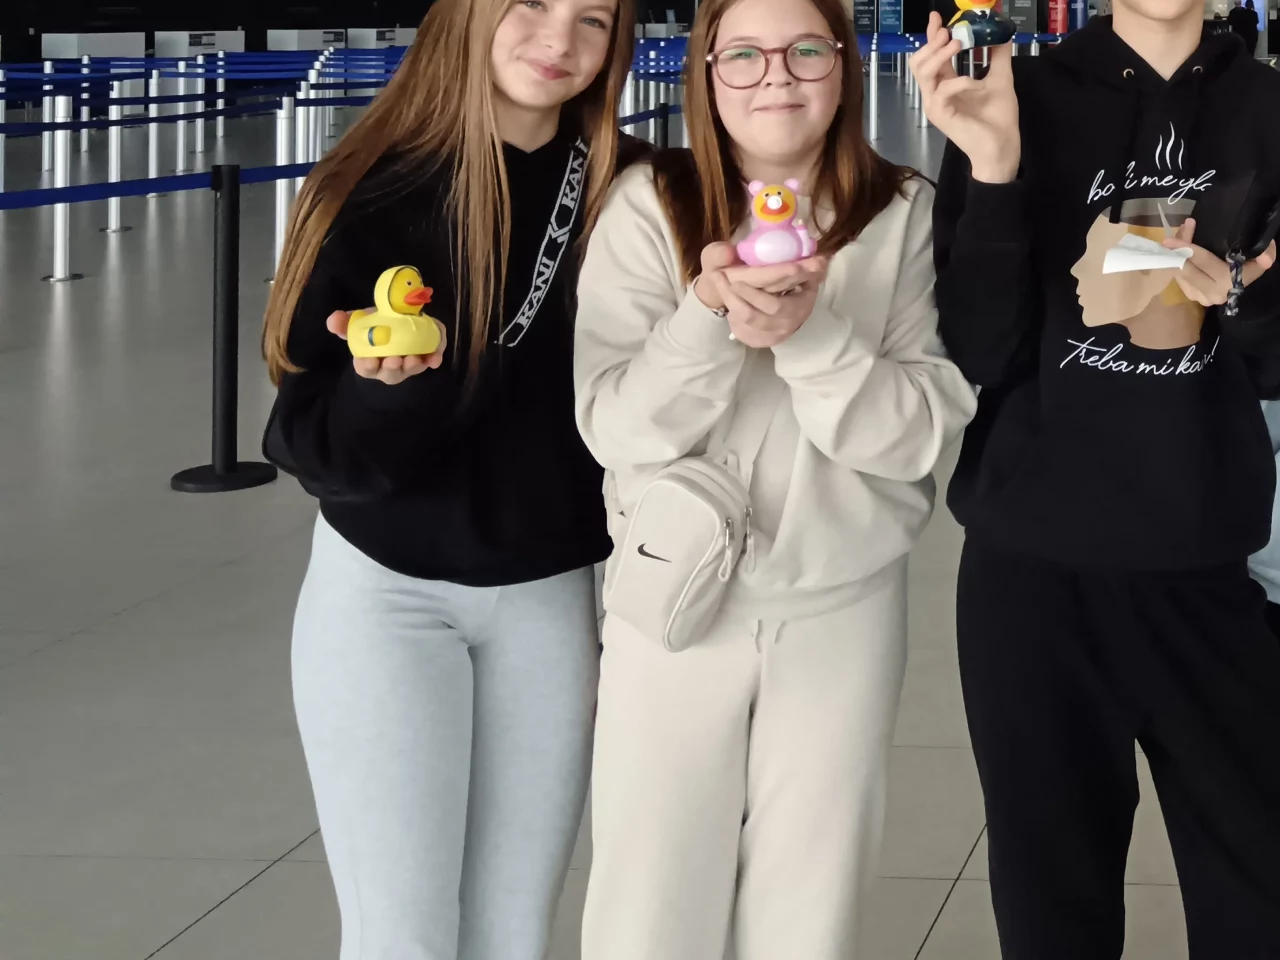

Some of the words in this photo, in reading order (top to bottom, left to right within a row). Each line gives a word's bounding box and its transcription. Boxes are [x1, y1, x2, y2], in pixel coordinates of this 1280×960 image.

[1140, 174, 1178, 187] me
[516, 256, 554, 328] KANI
[1136, 358, 1175, 376] mi
